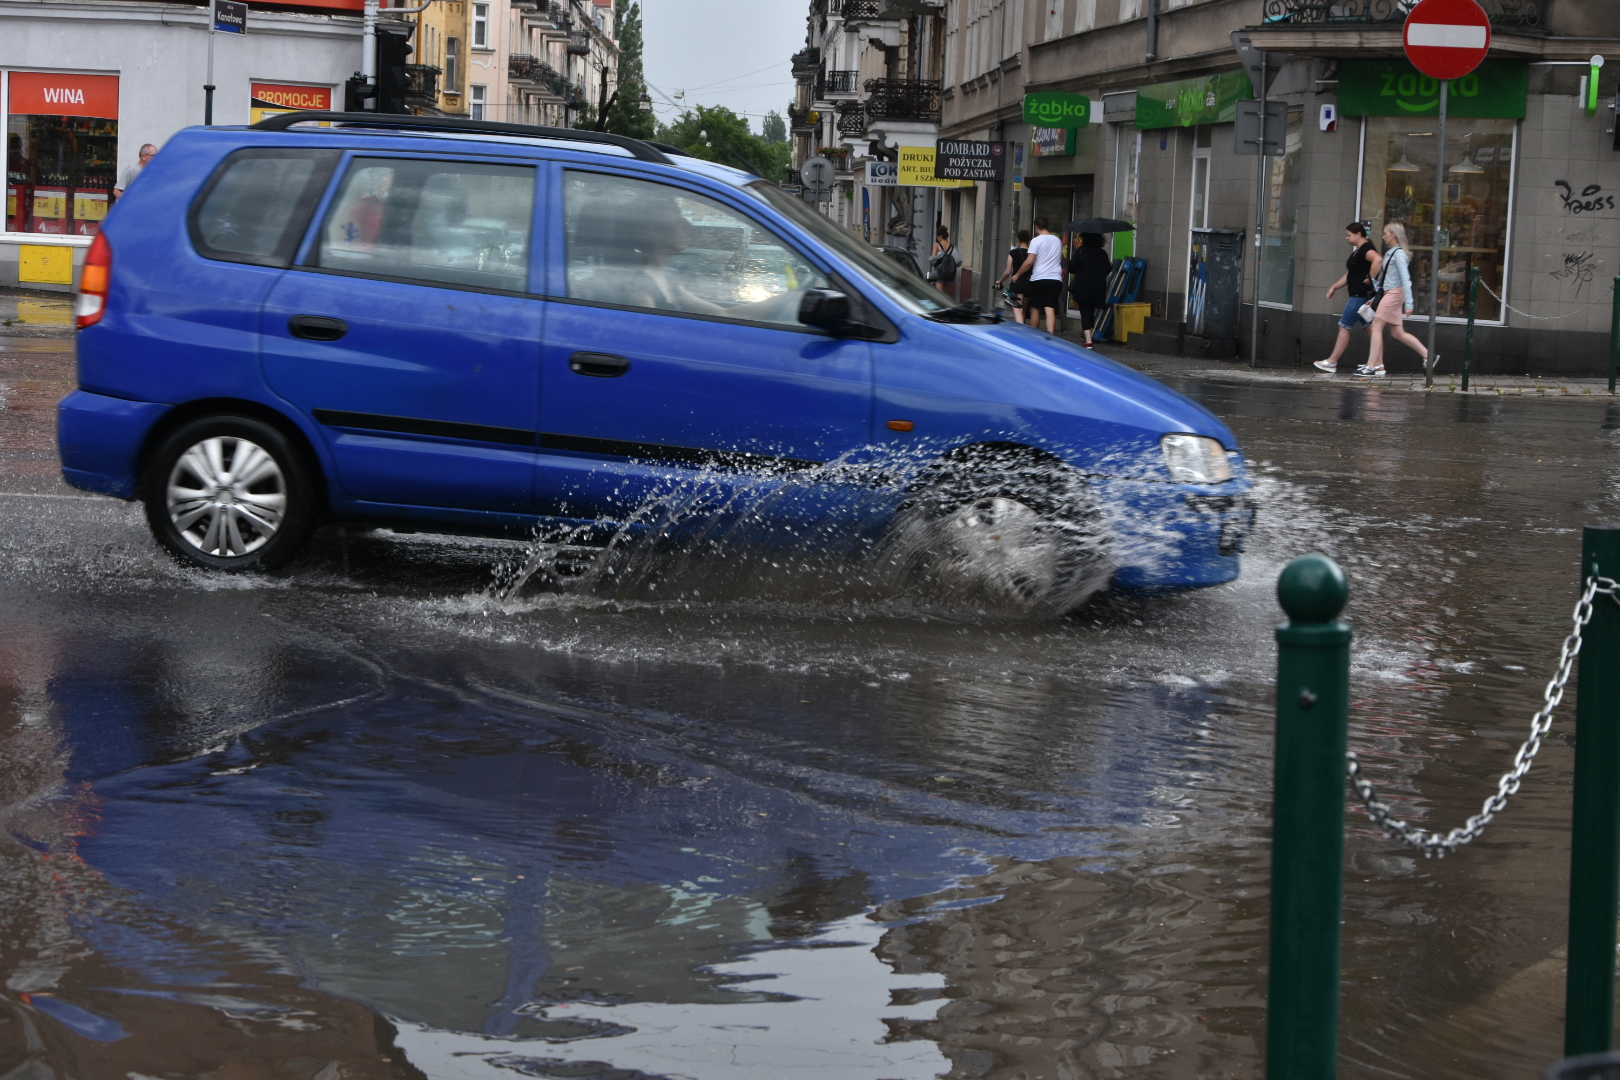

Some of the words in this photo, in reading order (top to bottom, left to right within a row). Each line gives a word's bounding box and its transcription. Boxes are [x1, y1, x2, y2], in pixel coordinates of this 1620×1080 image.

[217, 11, 243, 24] Kanałowa
[43, 87, 85, 105] WINA
[258, 90, 324, 108] PROMOCJE
[1029, 98, 1086, 117] żabka
[940, 141, 990, 156] LOMBARD
[902, 153, 934, 162] DRUKI
[949, 156, 992, 168] POŻYCZKI
[877, 163, 898, 176] OK
[901, 165, 918, 173] ART.
[944, 168, 961, 177] POD
[963, 168, 997, 178] ZASTAW
